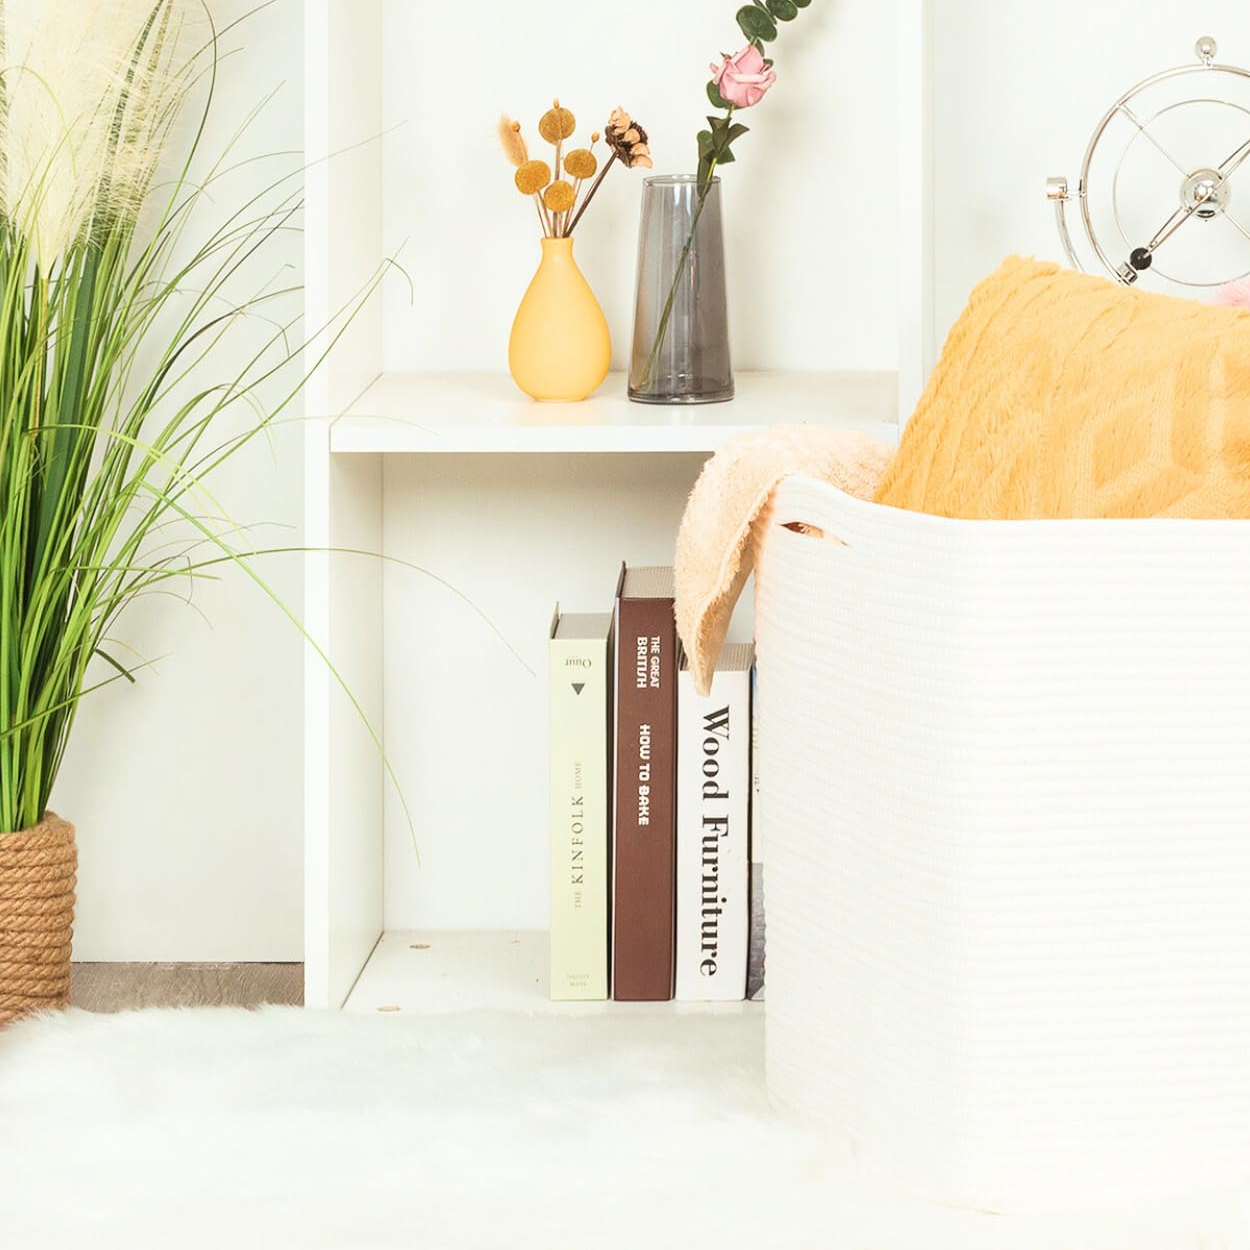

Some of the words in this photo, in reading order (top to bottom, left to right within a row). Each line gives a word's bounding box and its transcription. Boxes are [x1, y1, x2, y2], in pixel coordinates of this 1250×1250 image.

[650, 636, 661, 653] THE
[650, 656, 660, 688] GREAT
[639, 723, 651, 760] HOW
[703, 705, 729, 800] Wood
[574, 762, 582, 791] HOME
[638, 763, 650, 781] TO
[638, 785, 650, 826] BAKE
[572, 797, 583, 884] KINFOLK
[700, 815, 728, 976] Furniture
